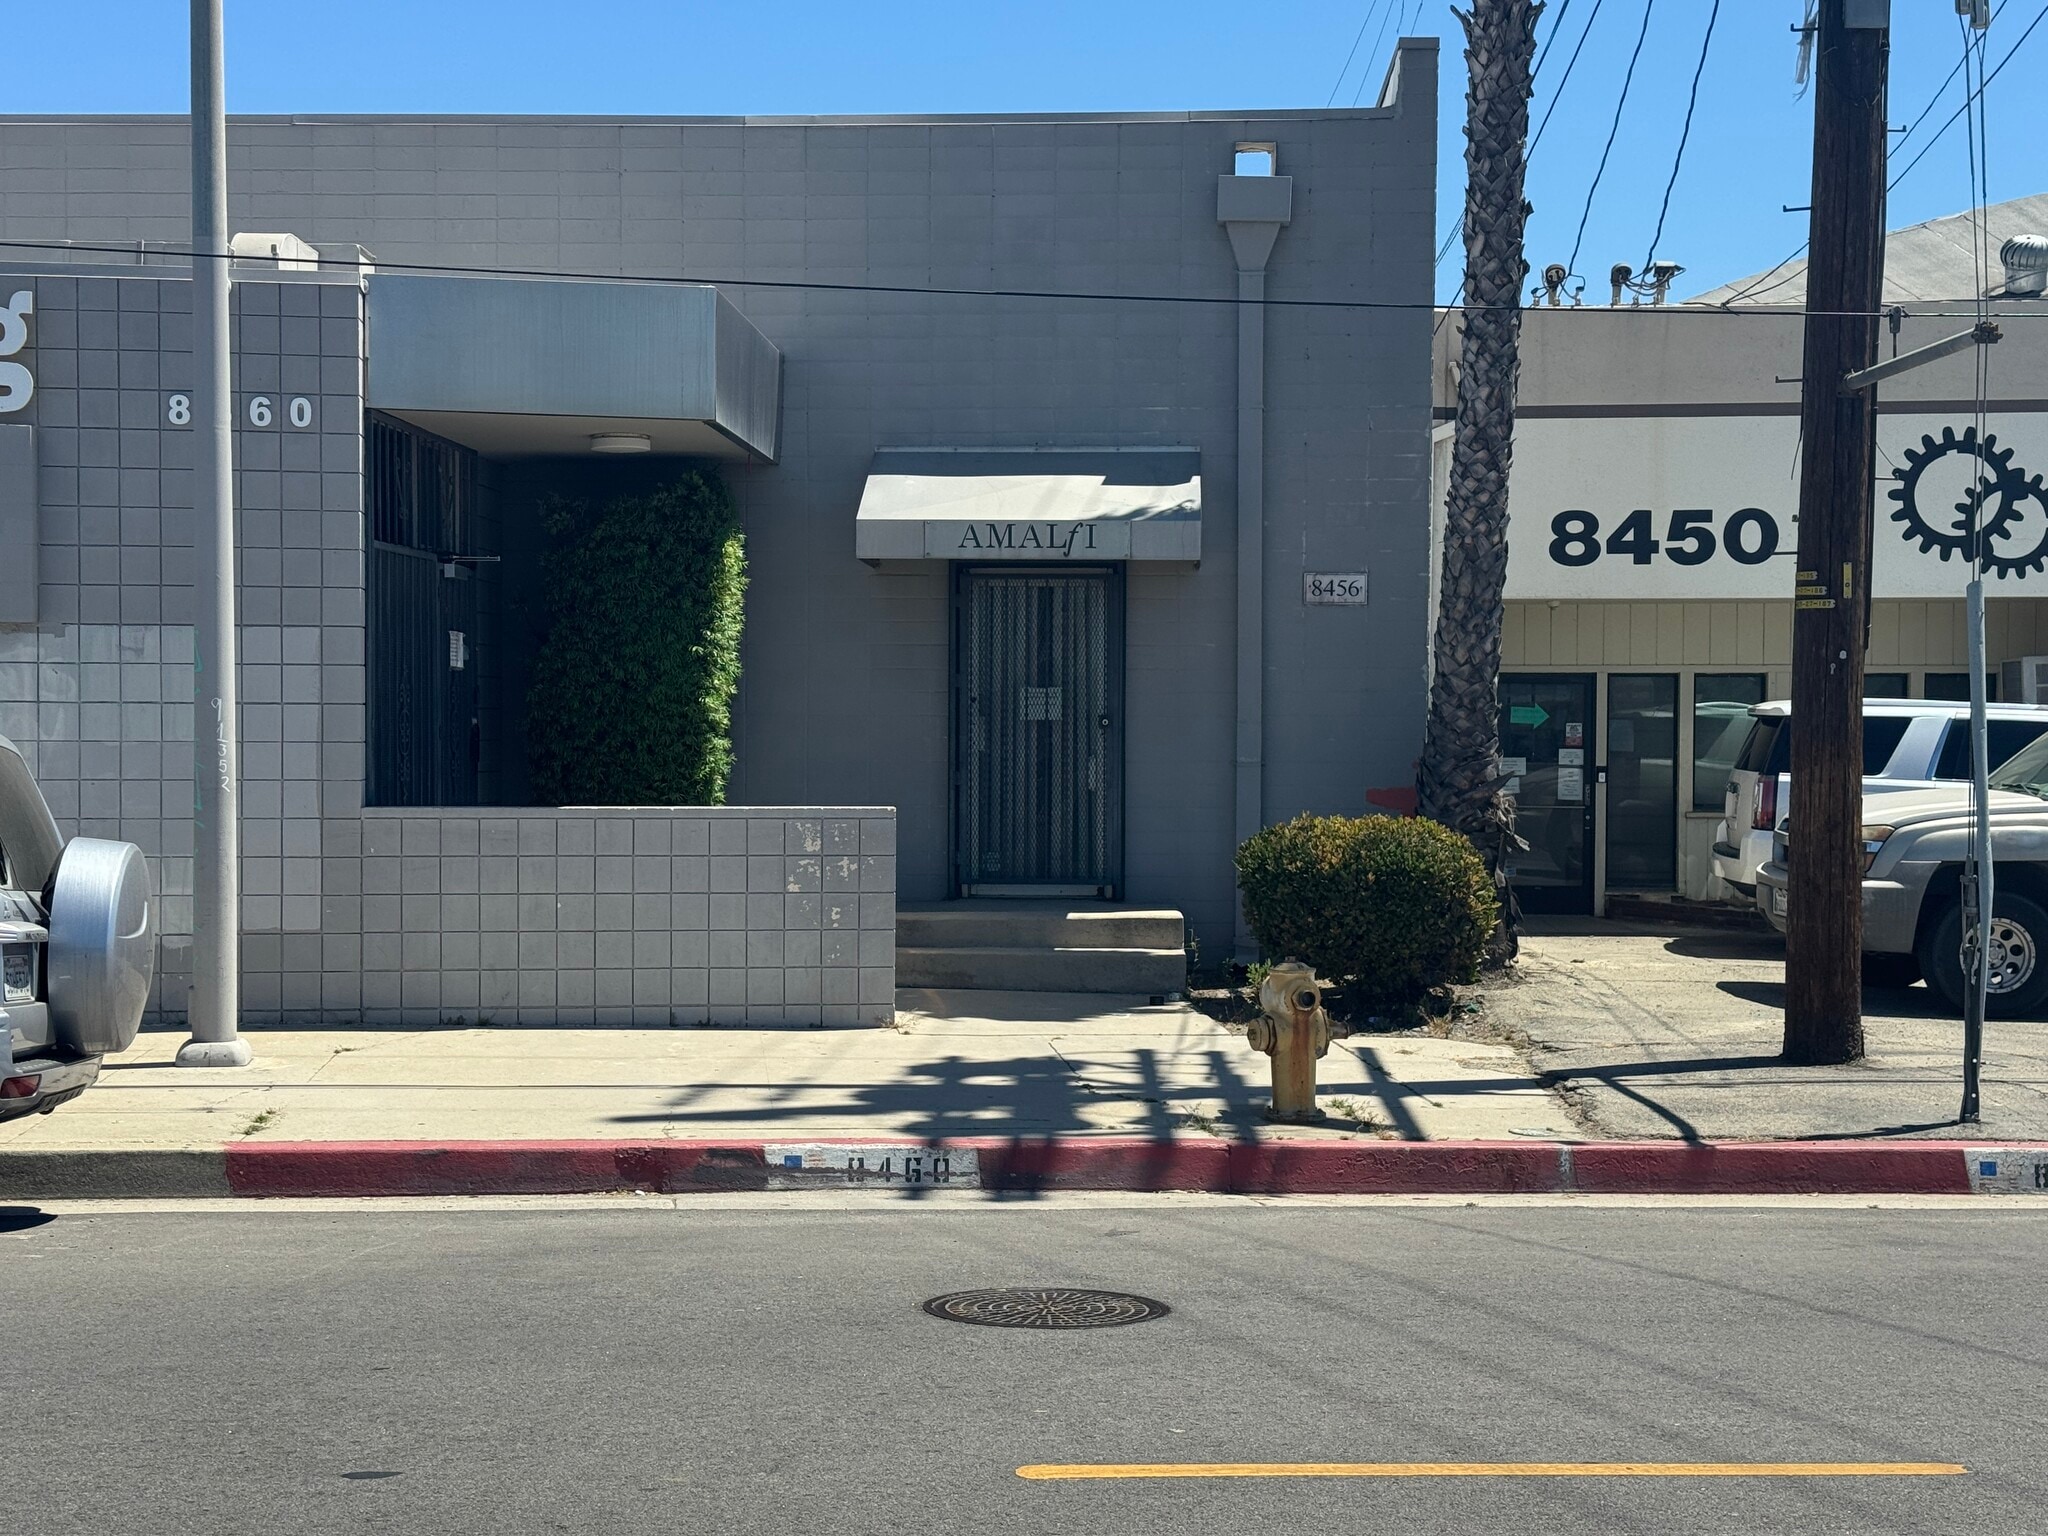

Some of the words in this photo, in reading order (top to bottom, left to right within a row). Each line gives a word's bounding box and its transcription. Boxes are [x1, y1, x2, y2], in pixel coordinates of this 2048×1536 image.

[168, 394, 312, 428] 860
[1549, 508, 1779, 566] 8450
[1311, 579, 1360, 597] 8456
[210, 697, 231, 793] 91352
[848, 1157, 950, 1183] 8460
